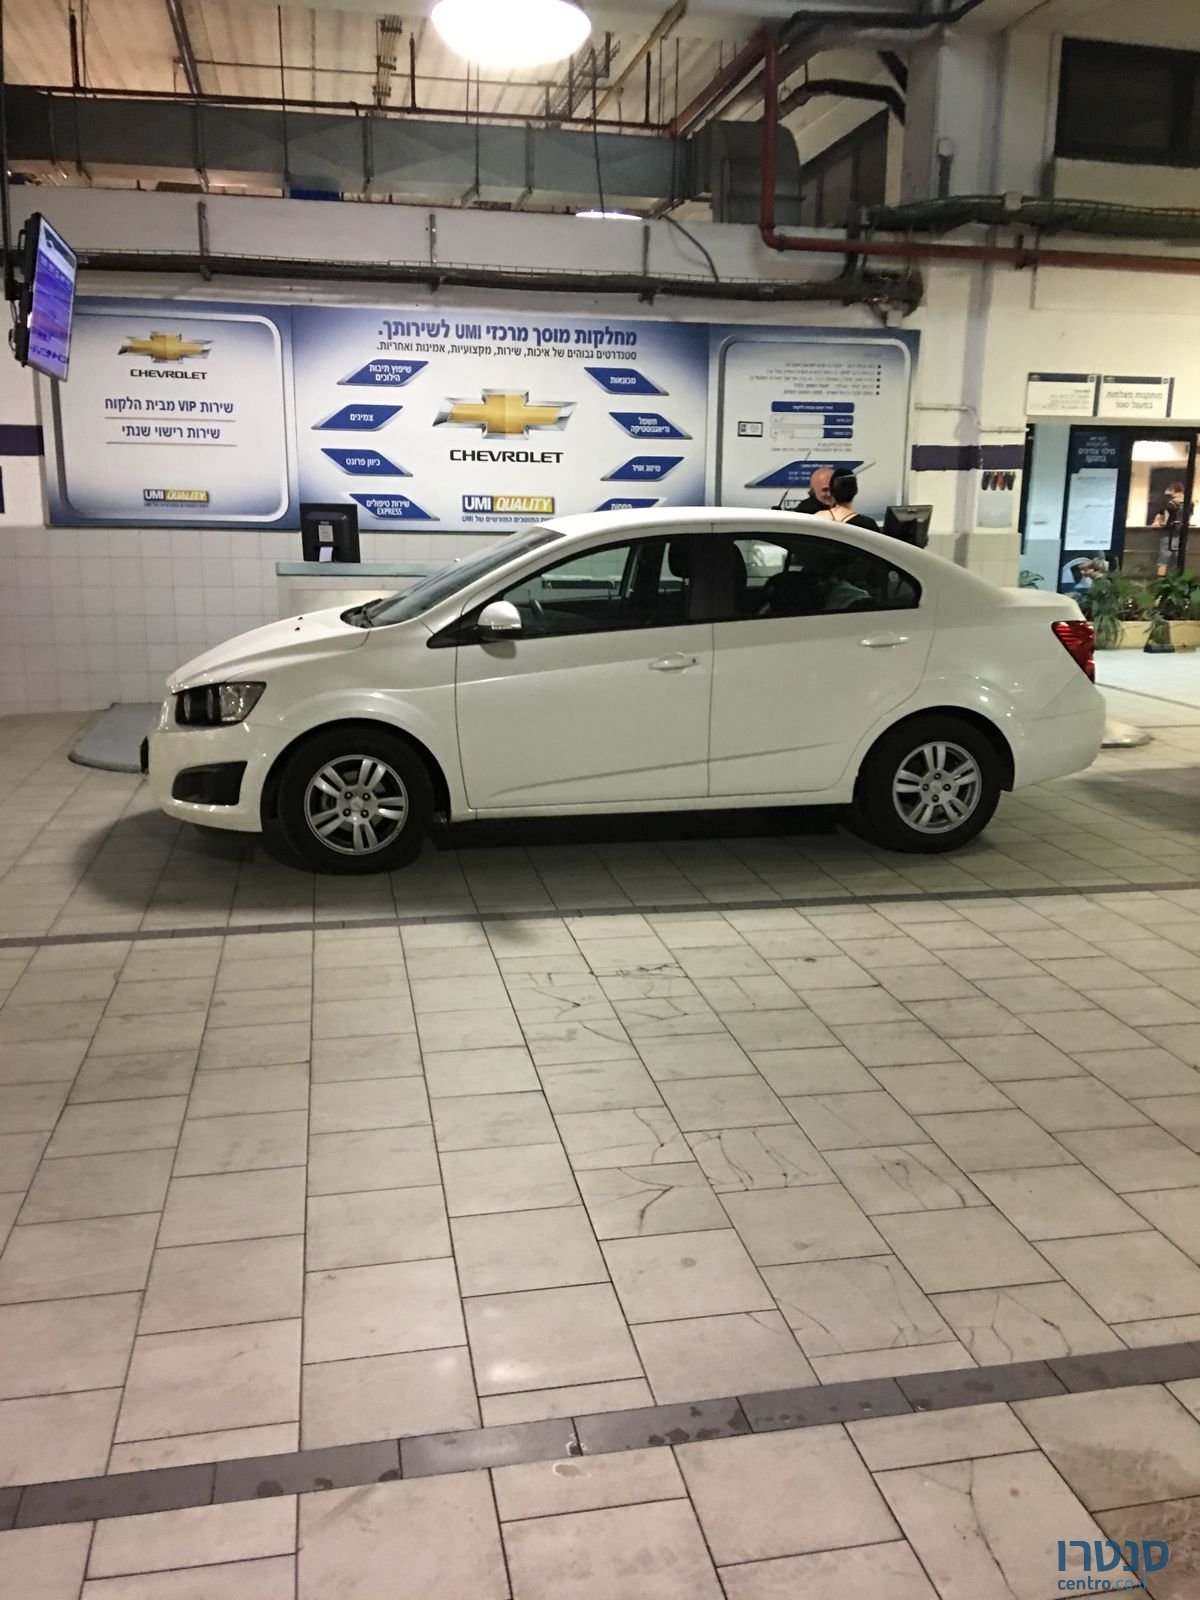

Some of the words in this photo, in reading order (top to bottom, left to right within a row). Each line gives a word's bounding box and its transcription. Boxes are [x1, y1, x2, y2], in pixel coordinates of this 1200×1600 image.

[378, 319, 450, 340] לשירותך.
[455, 324, 482, 340] UMI
[486, 325, 529, 341] מרכזי
[533, 327, 570, 346] מוסך
[575, 326, 637, 348] מחלקות
[416, 342, 446, 353] אמינות
[494, 345, 522, 356] שירות,
[524, 347, 550, 357] איכות,
[552, 347, 565, 358] של
[567, 348, 594, 359] גבוהים
[597, 350, 637, 360] סטנדרטים
[130, 368, 208, 380] CHEVROLET
[369, 364, 390, 373] תיבות
[391, 364, 412, 374] שיפוץ
[375, 373, 401, 382] הילוכים
[105, 396, 142, 412] הלקוח
[146, 399, 175, 411] מבית
[178, 400, 197, 412] VIP
[200, 401, 234, 414] שירות
[349, 413, 374, 422] צמיגים
[122, 425, 150, 437] שנתי
[154, 426, 183, 438] רישוי
[187, 426, 220, 439] שירות
[450, 449, 564, 463] CHEVROLET
[345, 458, 366, 466] פרונט
[367, 458, 380, 468] כיוון
[145, 490, 165, 500] UMI
[167, 490, 208, 501] QUALITY
[366, 499, 391, 508] טיפולים
[391, 500, 410, 508] שירות
[464, 496, 492, 511] UMI
[495, 496, 552, 512] QUALITY
